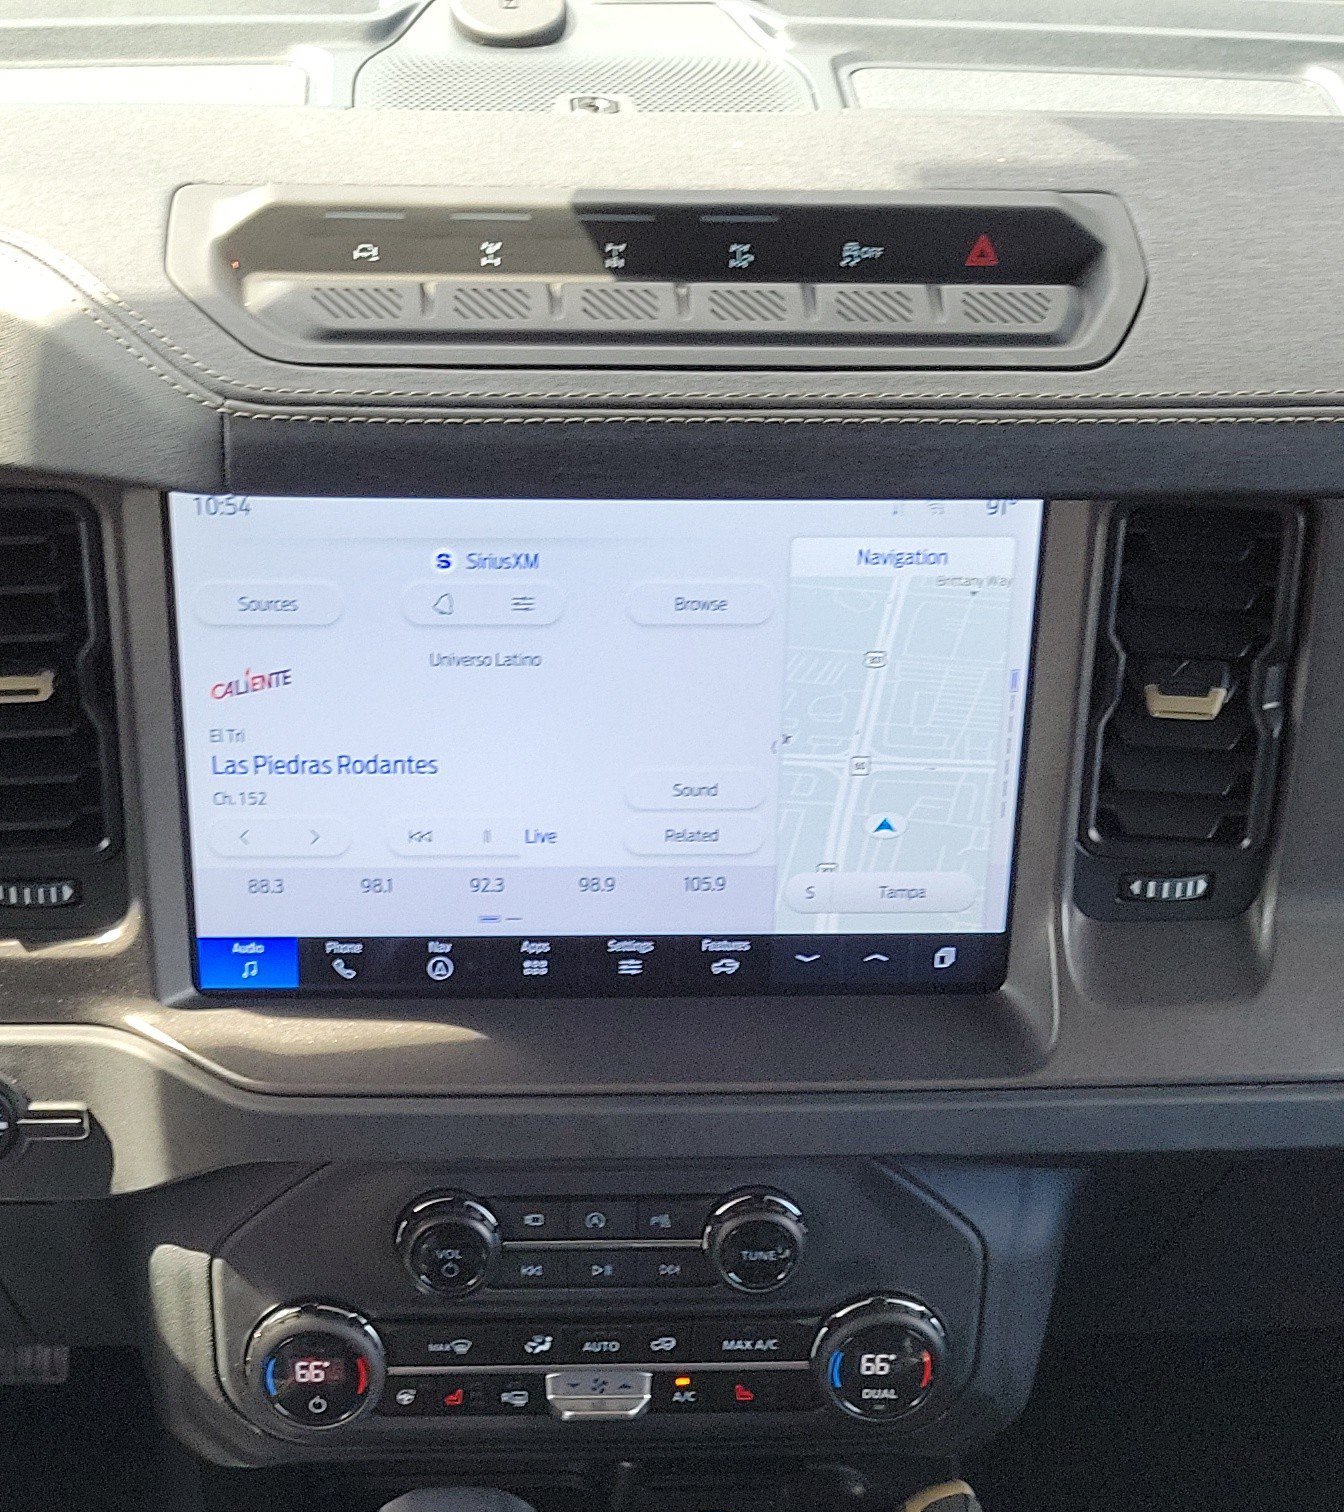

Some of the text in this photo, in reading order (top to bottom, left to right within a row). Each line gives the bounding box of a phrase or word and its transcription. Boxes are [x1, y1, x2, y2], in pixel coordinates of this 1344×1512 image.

[193, 496, 252, 516] 10:54
[465, 552, 540, 571] SiriusXM
[856, 547, 949, 569] Navigation
[236, 596, 299, 613] Sources
[674, 596, 729, 613] Browse
[429, 652, 542, 668] Universo Latino
[209, 728, 224, 743] El
[211, 754, 439, 776] Las Piedras Rodantes
[672, 781, 719, 798] Sound
[238, 791, 268, 806] 152
[524, 828, 558, 845] Live
[664, 828, 720, 844] Related
[247, 878, 285, 894] 88.3
[360, 877, 393, 894] 98.1
[469, 876, 505, 893] 92.3
[578, 876, 616, 893] 98.9
[683, 875, 727, 892] 105.9
[878, 884, 927, 901] Tampa
[231, 941, 265, 955] Audio
[325, 941, 363, 955] Phone
[428, 940, 453, 954] Nav
[520, 940, 551, 956] Apps
[606, 938, 655, 955] Settings
[701, 938, 752, 954] Features
[582, 1340, 621, 1352] AUTO
[722, 1338, 779, 1351] MAX A/C
[672, 1389, 697, 1403] A/C
[861, 1387, 899, 1400] DUAL
